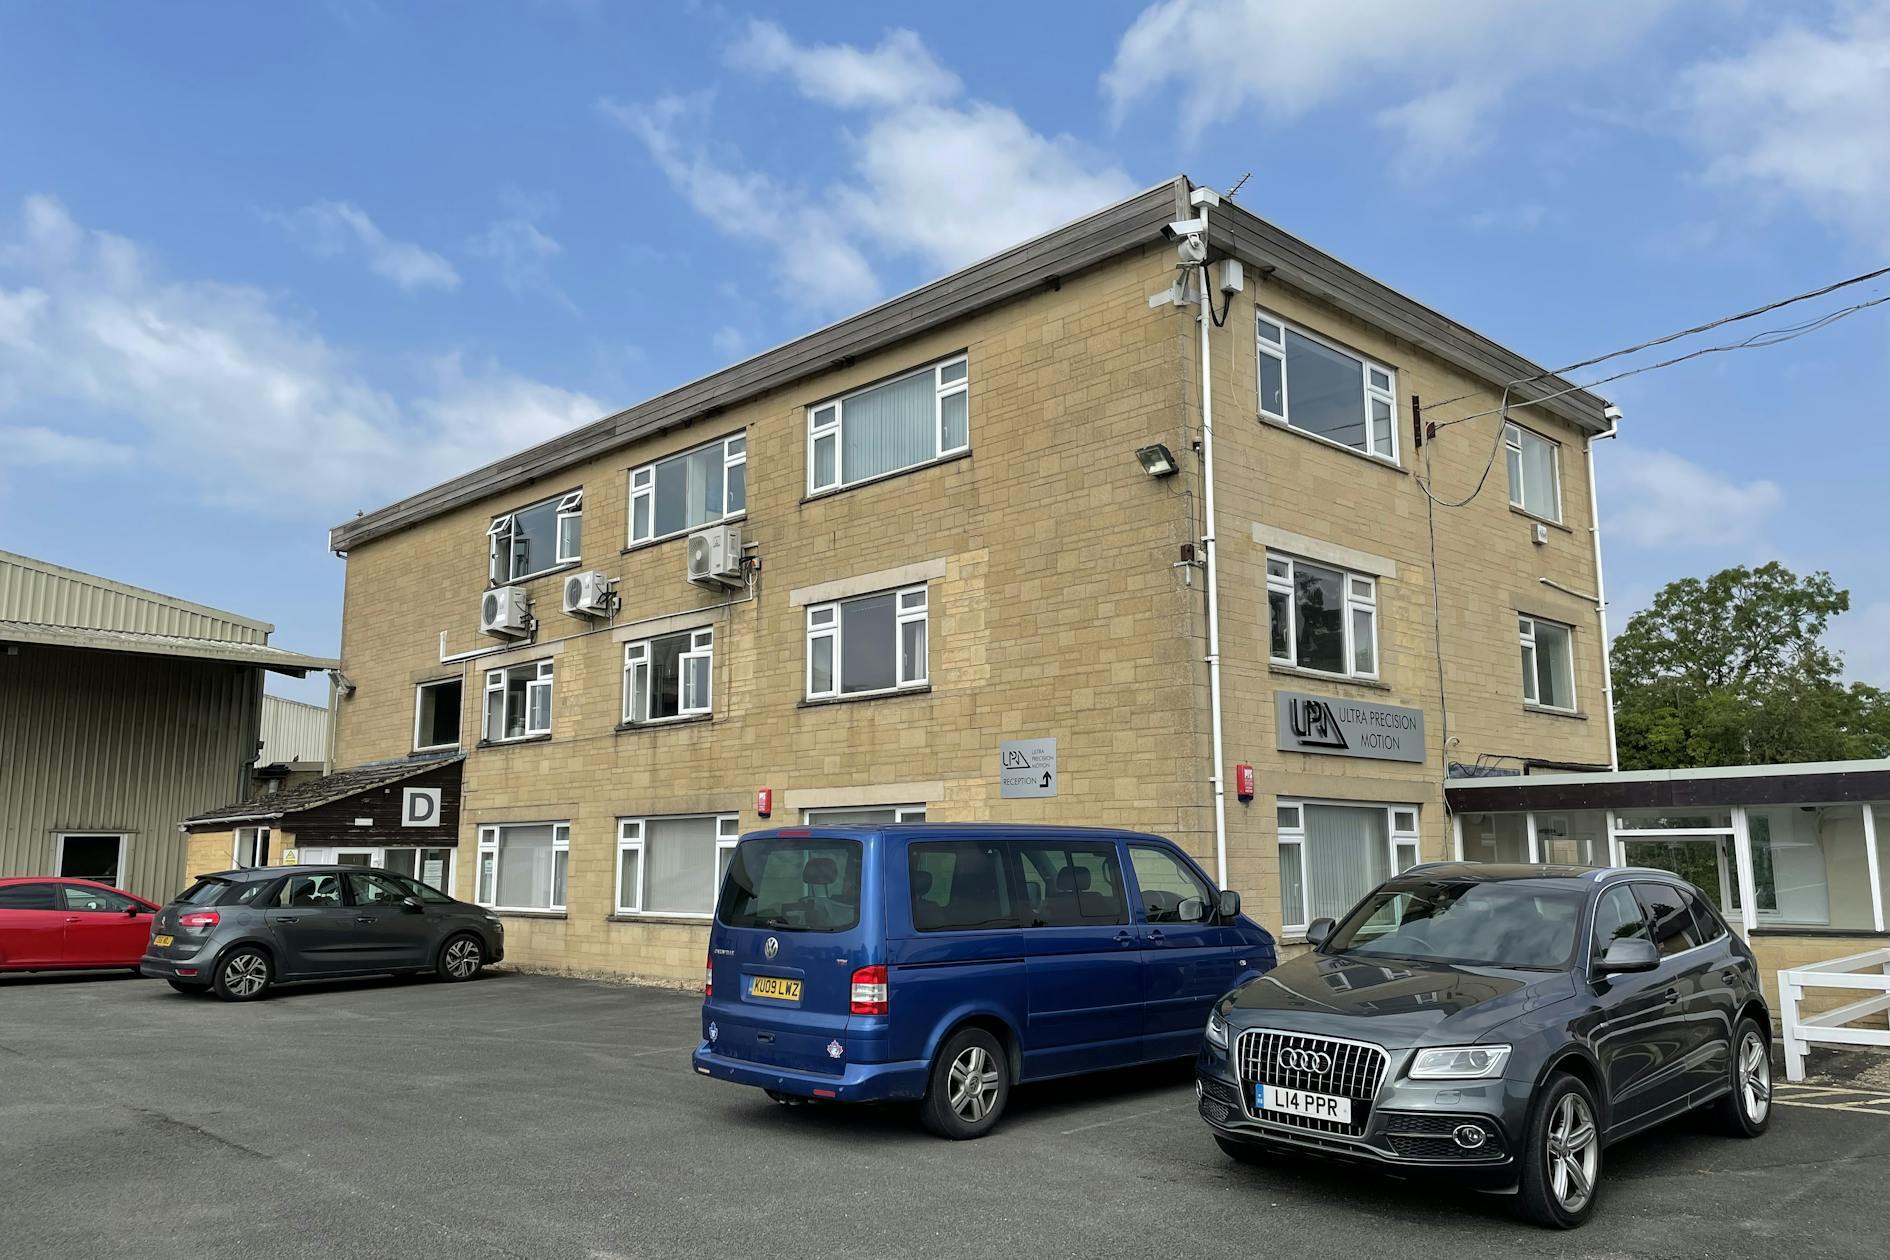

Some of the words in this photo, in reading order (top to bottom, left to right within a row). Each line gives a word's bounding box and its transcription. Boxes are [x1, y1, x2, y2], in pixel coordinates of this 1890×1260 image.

[1339, 706, 1368, 725] ULTRA
[1369, 711, 1417, 731] PRECISION
[1360, 733, 1400, 750] MOTION
[1003, 776, 1037, 786] RECEPTION
[408, 792, 434, 822] D
[753, 977, 777, 994] KU09
[778, 981, 800, 997] LWZ
[1304, 1094, 1338, 1117] PPR
